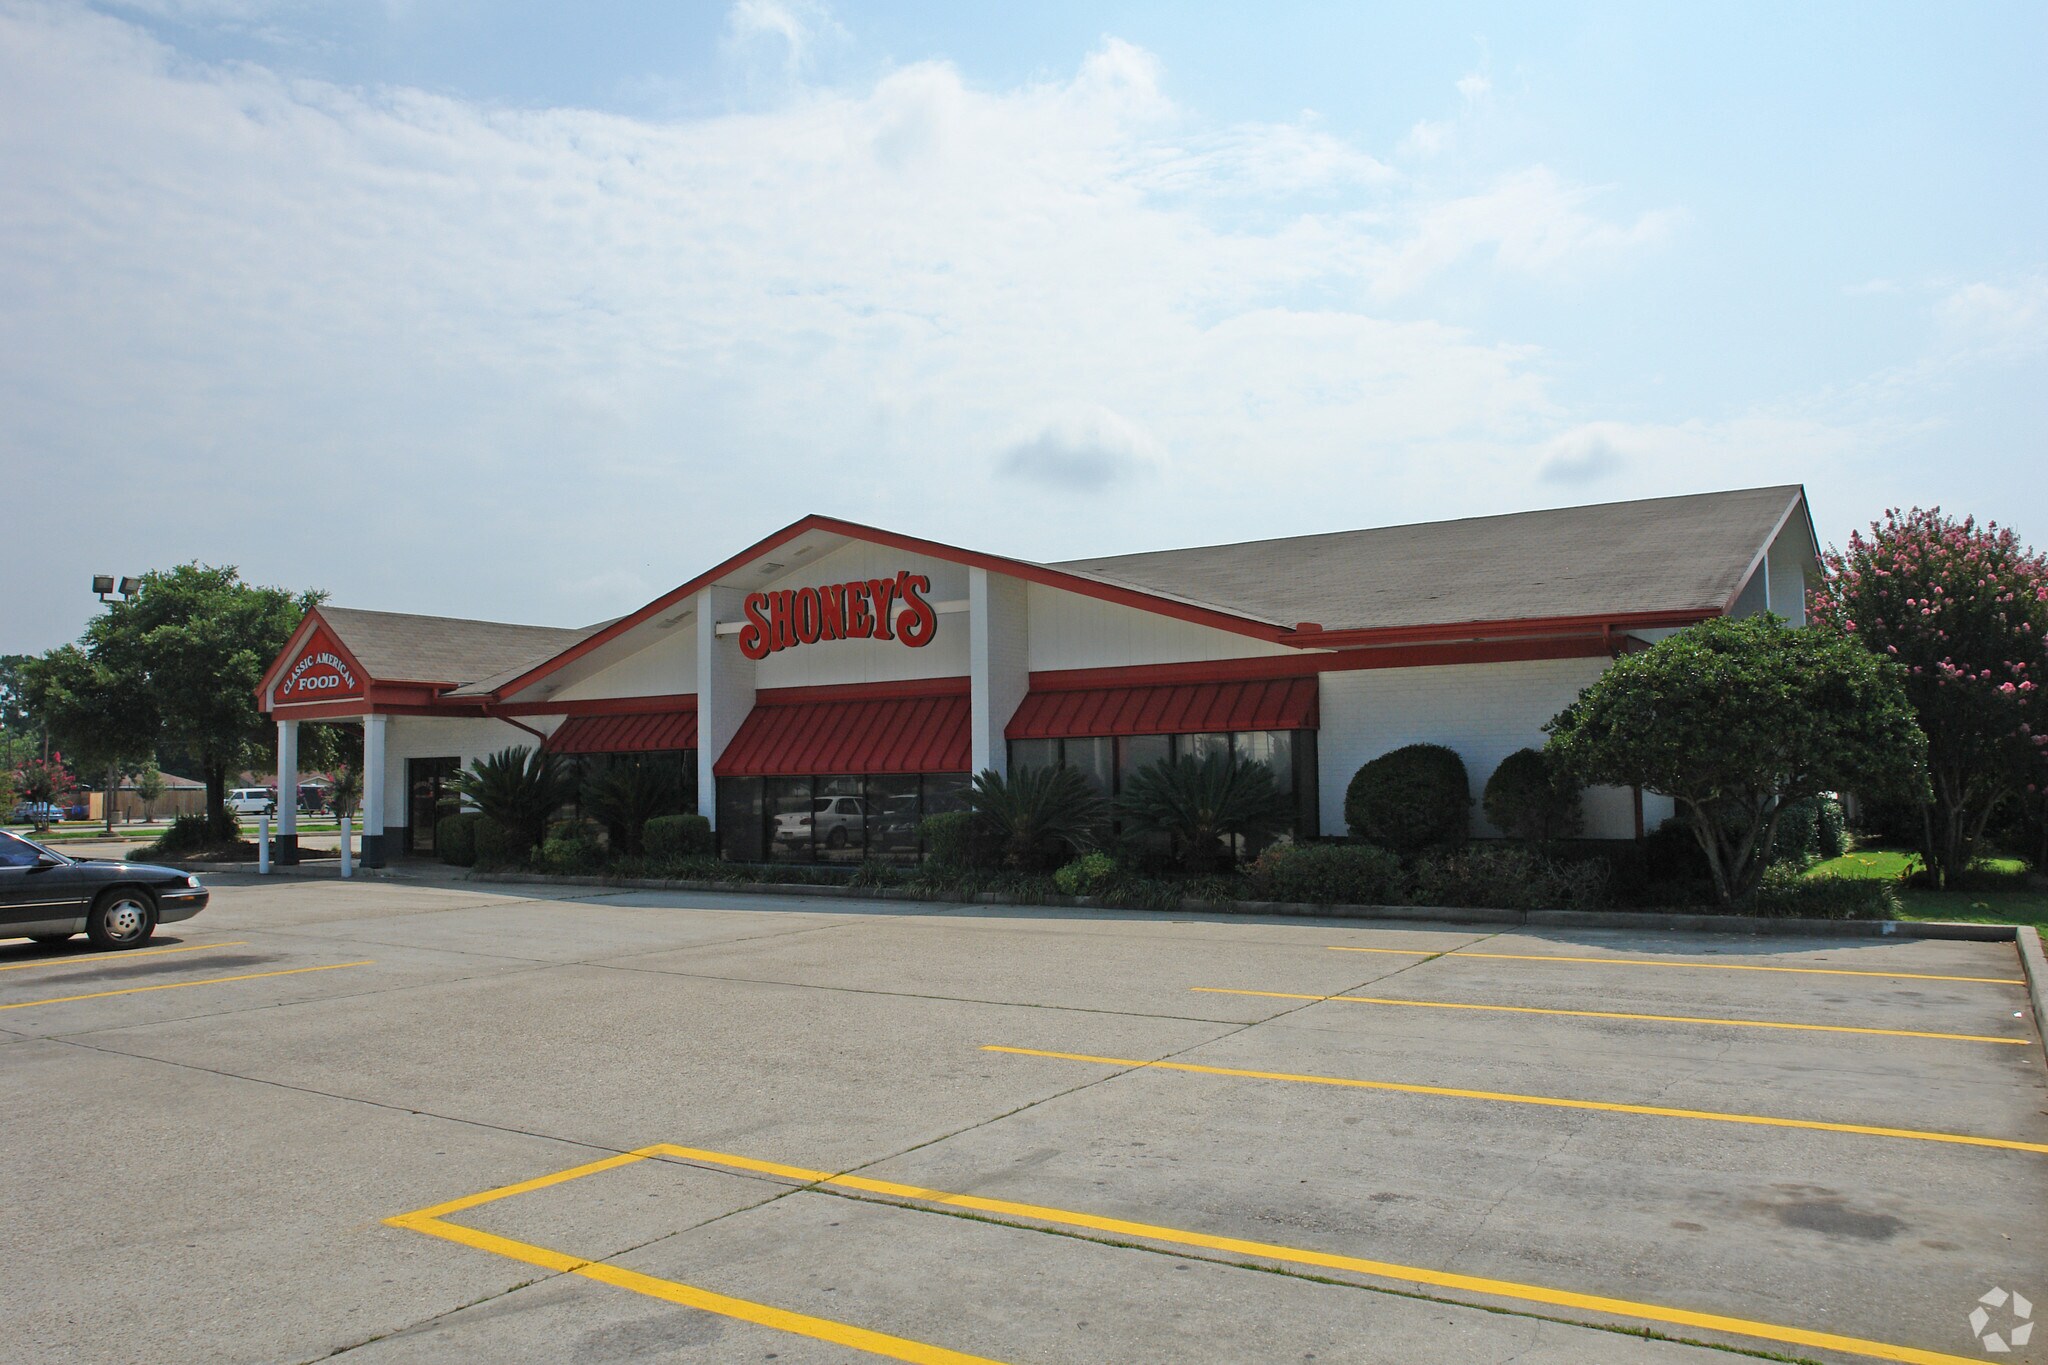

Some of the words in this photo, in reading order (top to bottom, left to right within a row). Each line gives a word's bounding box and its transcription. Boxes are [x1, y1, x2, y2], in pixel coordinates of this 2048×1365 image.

[739, 570, 937, 660] SHONEY'S
[283, 655, 314, 695] CLASSIC
[315, 652, 356, 690] AMERICAN
[298, 675, 340, 691] FOOD
